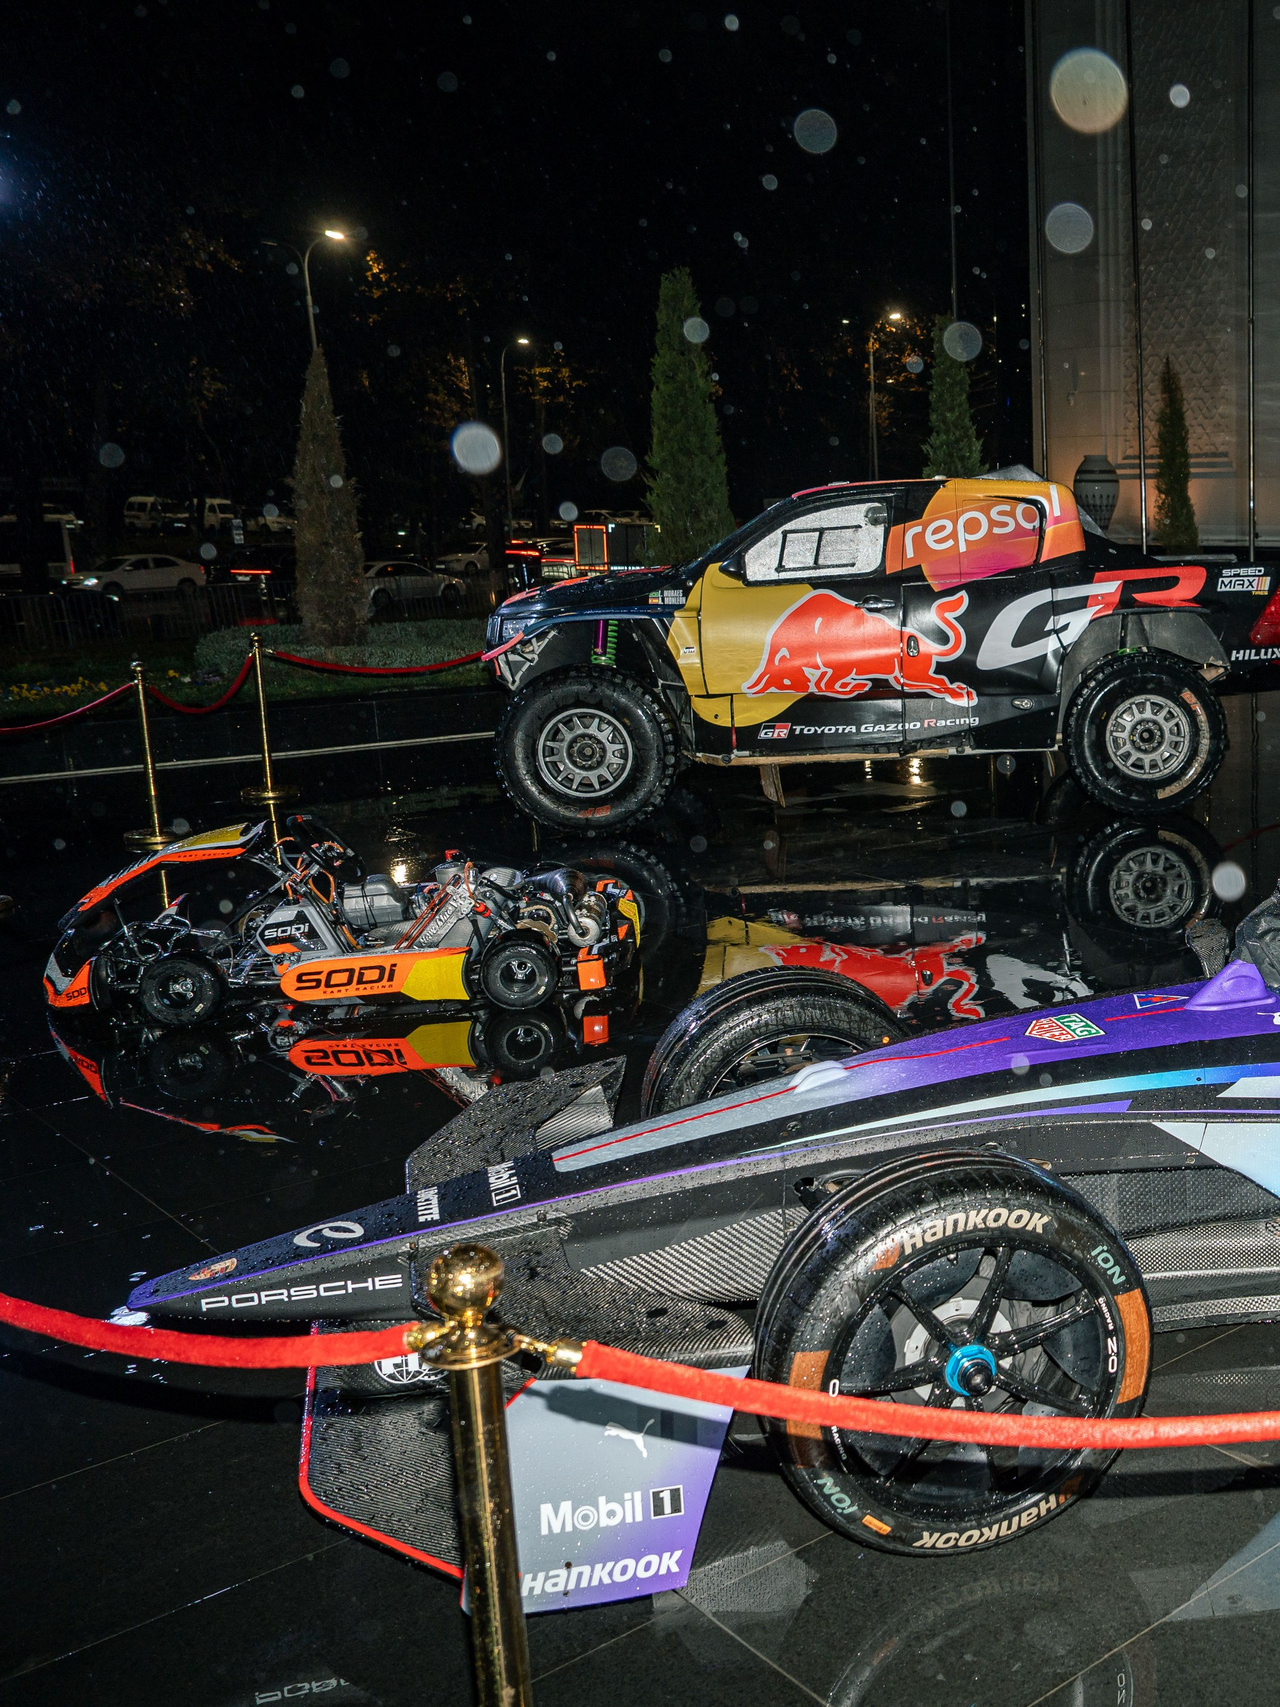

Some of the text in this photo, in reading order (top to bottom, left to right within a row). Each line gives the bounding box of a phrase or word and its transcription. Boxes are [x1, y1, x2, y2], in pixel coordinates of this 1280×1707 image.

[904, 484, 1061, 559] repsol
[1222, 567, 1265, 577] SPEED
[1219, 579, 1257, 590] MAX
[976, 566, 1207, 670] GR
[760, 717, 980, 739] GR TOYOTA GAZOO Racing
[354, 983, 394, 992] RACING
[1033, 1019, 1071, 1040] HEUER
[1060, 1015, 1098, 1036] TAG
[200, 1274, 404, 1312] PORSCHE
[1098, 1297, 1114, 1331] RACING
[540, 1491, 643, 1536] Mobil
